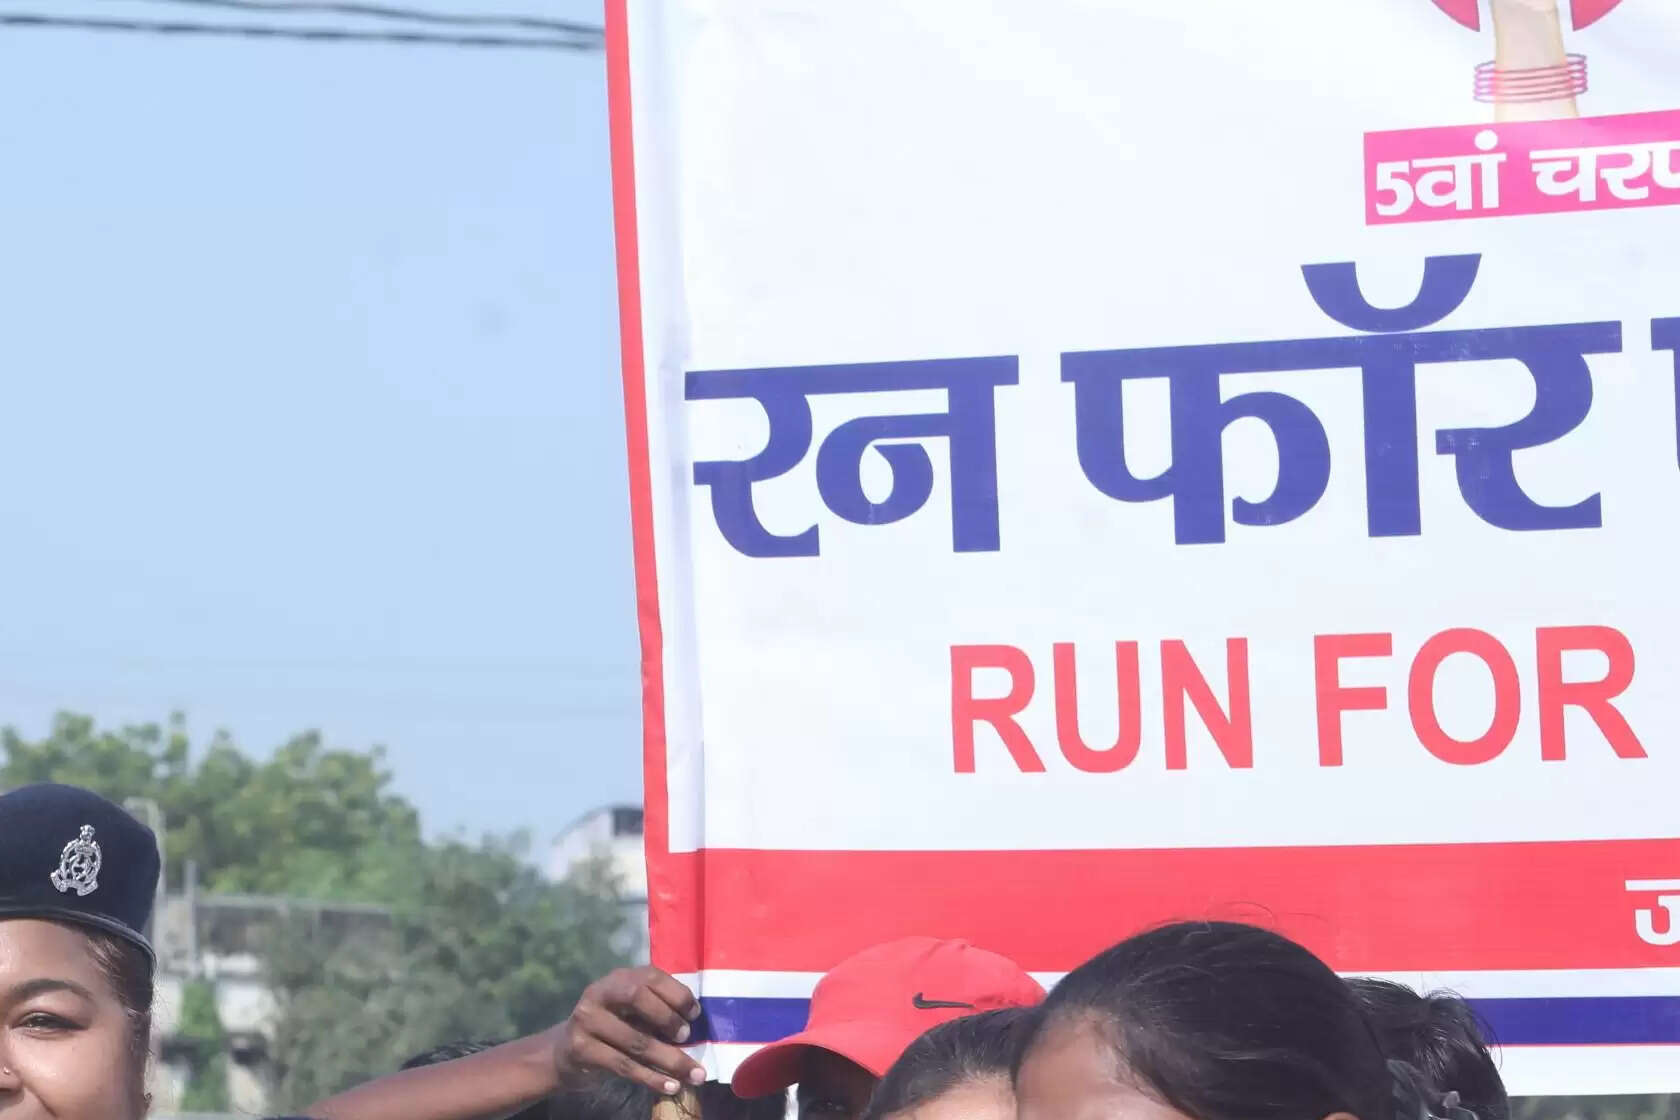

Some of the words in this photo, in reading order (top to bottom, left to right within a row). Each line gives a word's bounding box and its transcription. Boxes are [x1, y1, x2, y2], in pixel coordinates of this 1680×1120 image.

[1376, 129, 1507, 216] 5वां
[685, 356, 1019, 558] रन
[1061, 254, 1622, 545] फॉर
[952, 637, 1253, 773] RUN
[1315, 626, 1646, 766] FOR
